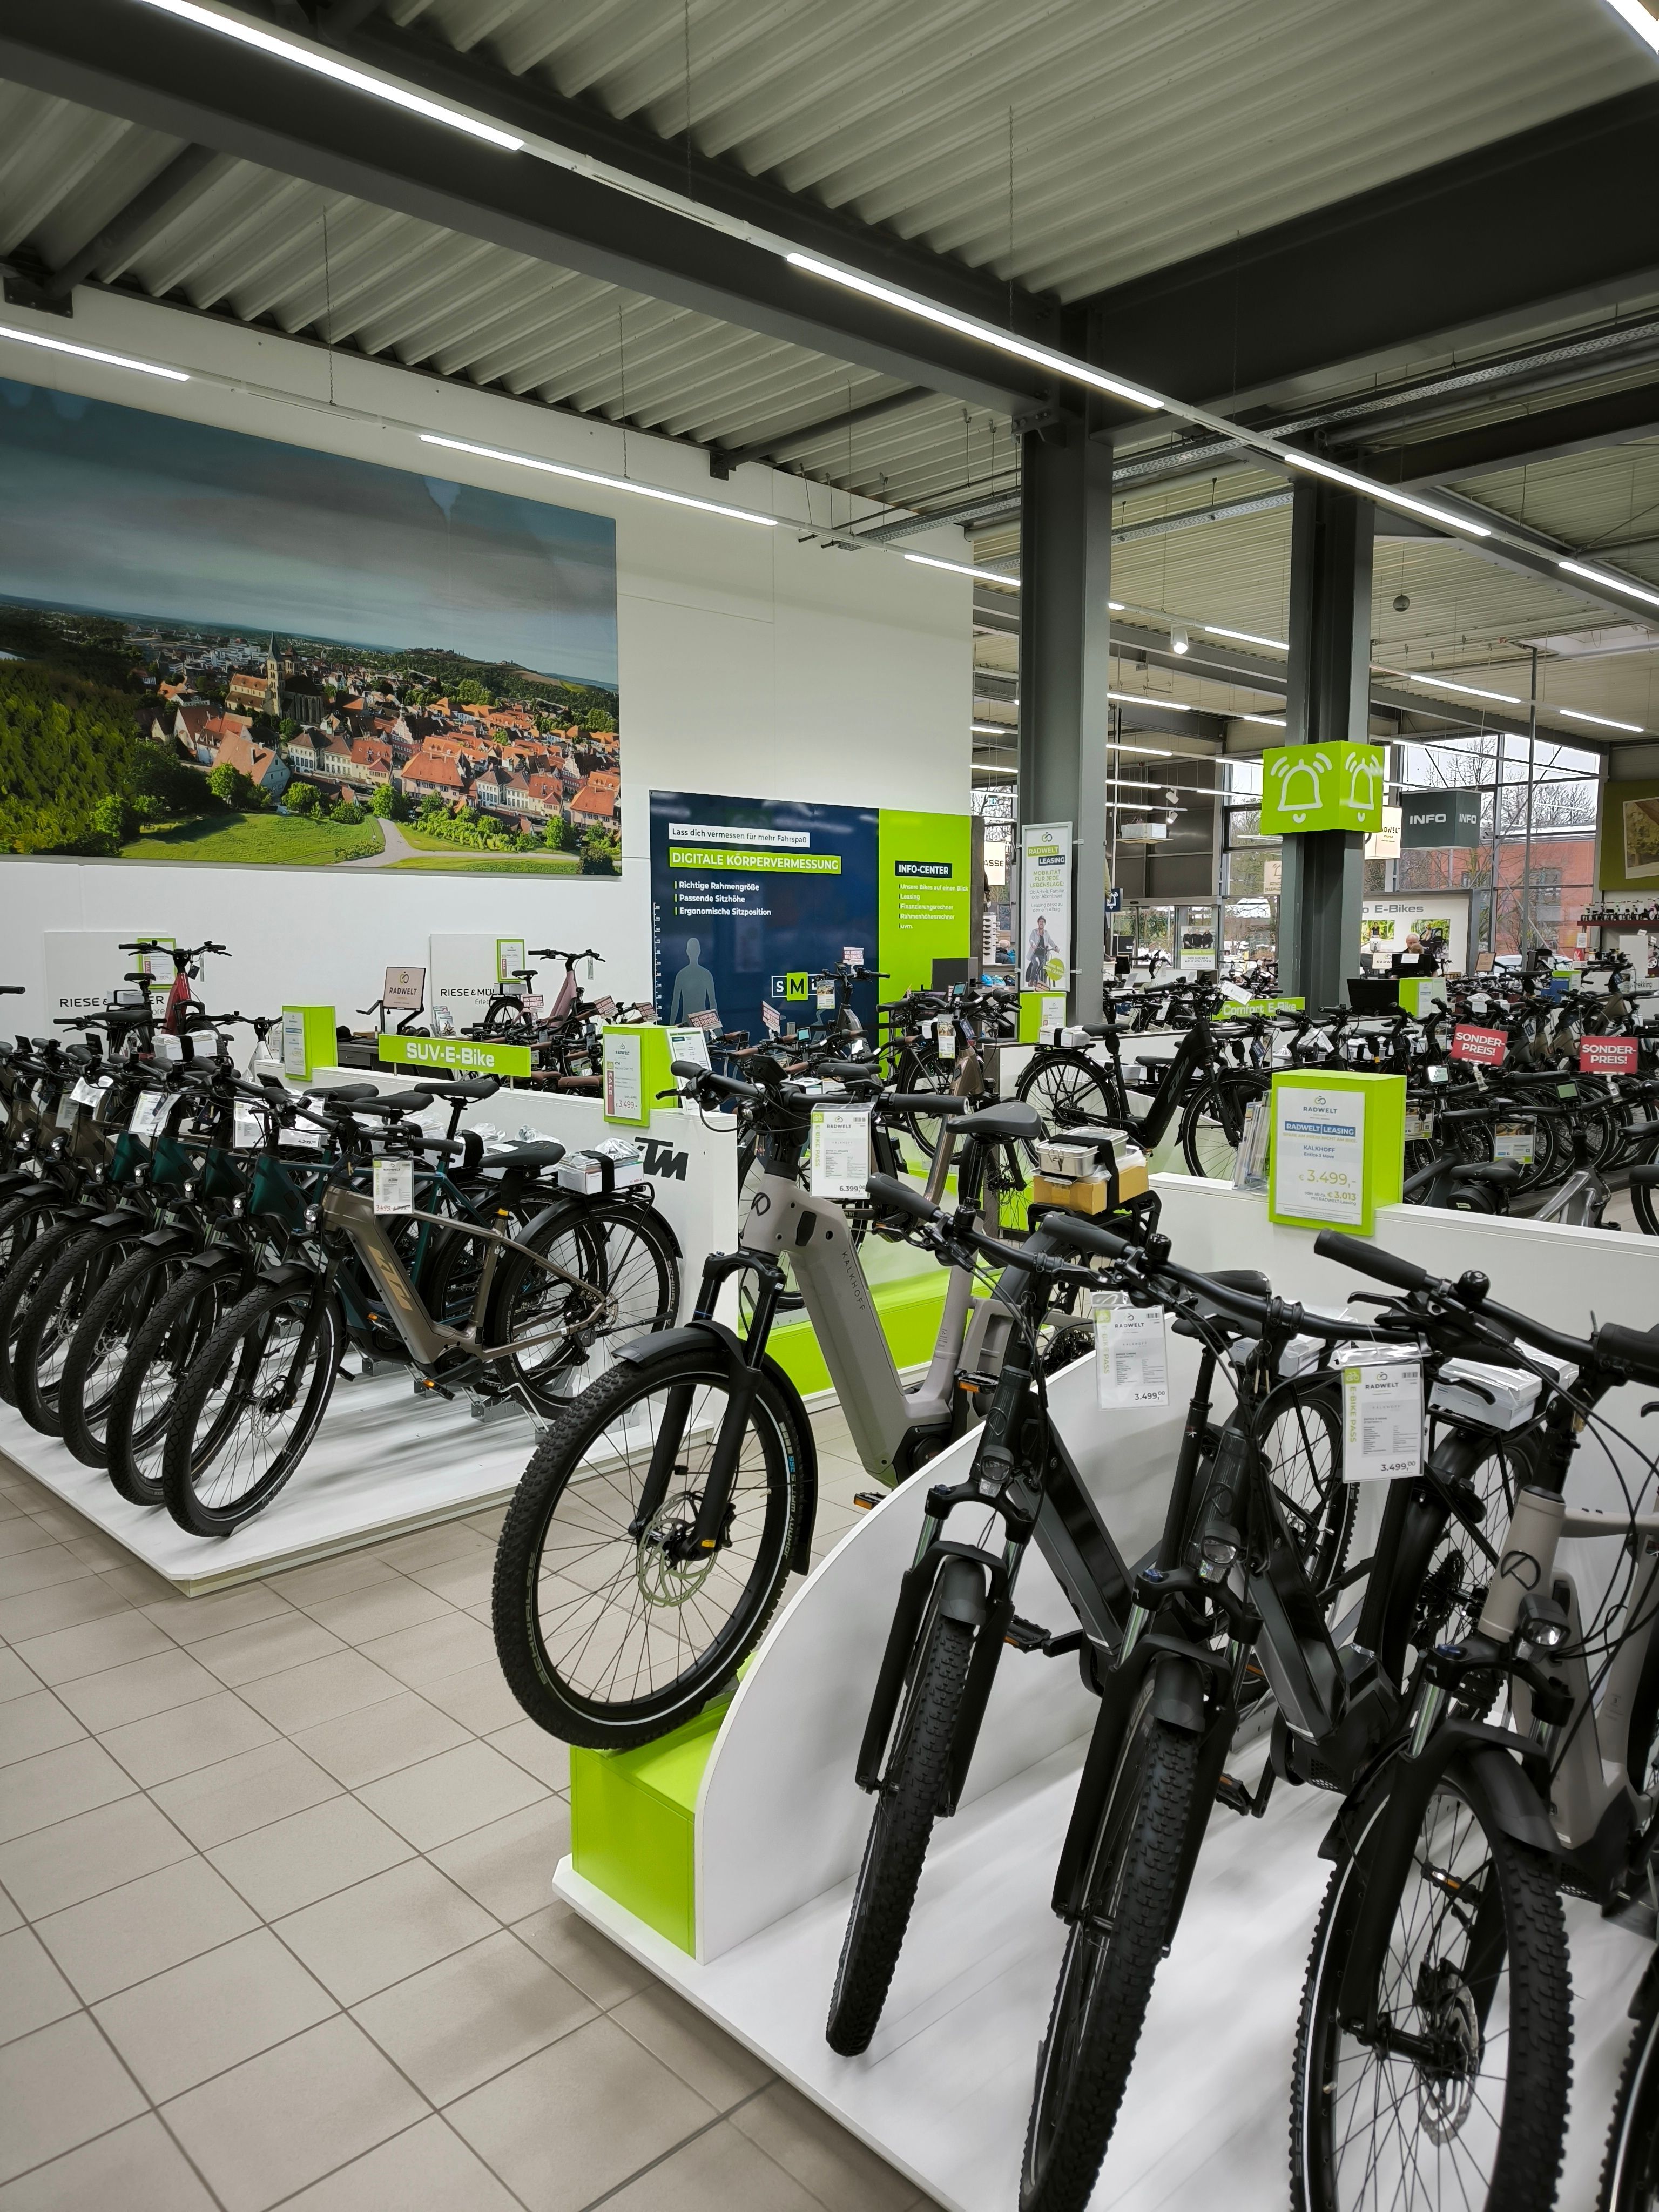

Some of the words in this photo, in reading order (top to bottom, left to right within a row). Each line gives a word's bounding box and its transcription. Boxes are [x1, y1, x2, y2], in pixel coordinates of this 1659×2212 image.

[1410, 813, 1447, 825] INFO
[1459, 813, 1477, 824] INFO
[707, 832, 745, 840] vermessen
[747, 832, 756, 840] für
[777, 835, 806, 844] Fahrspaß
[672, 852, 723, 865] DIGITALE
[727, 853, 838, 870] KÖRPERVERMESSUNG
[899, 864, 949, 874] INFO-CENTER
[679, 881, 709, 891] Richtige
[711, 882, 759, 892] Rahmengröße
[679, 894, 713, 902] Passende
[679, 907, 730, 917] Ergonomische
[732, 908, 771, 918] Sitzposition
[1374, 905, 1424, 913] E-Bikes
[776, 981, 784, 993] S
[791, 979, 804, 994] M
[1636, 981, 1653, 989] rekking
[389, 987, 417, 995] RADWELT
[60, 998, 100, 1007] RIESE
[1223, 1004, 1264, 1016] Comfort
[1268, 1002, 1297, 1013] E-Bike
[1456, 1031, 1505, 1047] SONDER-
[407, 1042, 495, 1067] SUV-E-Bike
[1462, 1043, 1495, 1056] PREIS!
[1582, 1044, 1636, 1054] SONDER-
[1591, 1055, 1628, 1064] PREIS!
[618, 1100, 637, 1110] 3.499,-
[1286, 1123, 1320, 1132] RADWELT
[1323, 1125, 1354, 1135] LEASING
[631, 1137, 689, 1181] TM
[1307, 1170, 1356, 1188] 3.499,-
[839, 1185, 866, 1193] 6.399,00
[1319, 1197, 1356, 1206] RADWELT-Leasing
[842, 1251, 865, 1310] KALKHOFF
[667, 1260, 675, 1325] SCHWALE
[1135, 1391, 1165, 1400] 3.499,00
[1381, 1461, 1416, 1472] 3.499,00
[784, 1516, 795, 1559] JOHNNY
[526, 1552, 548, 1685] SCHWALBE
